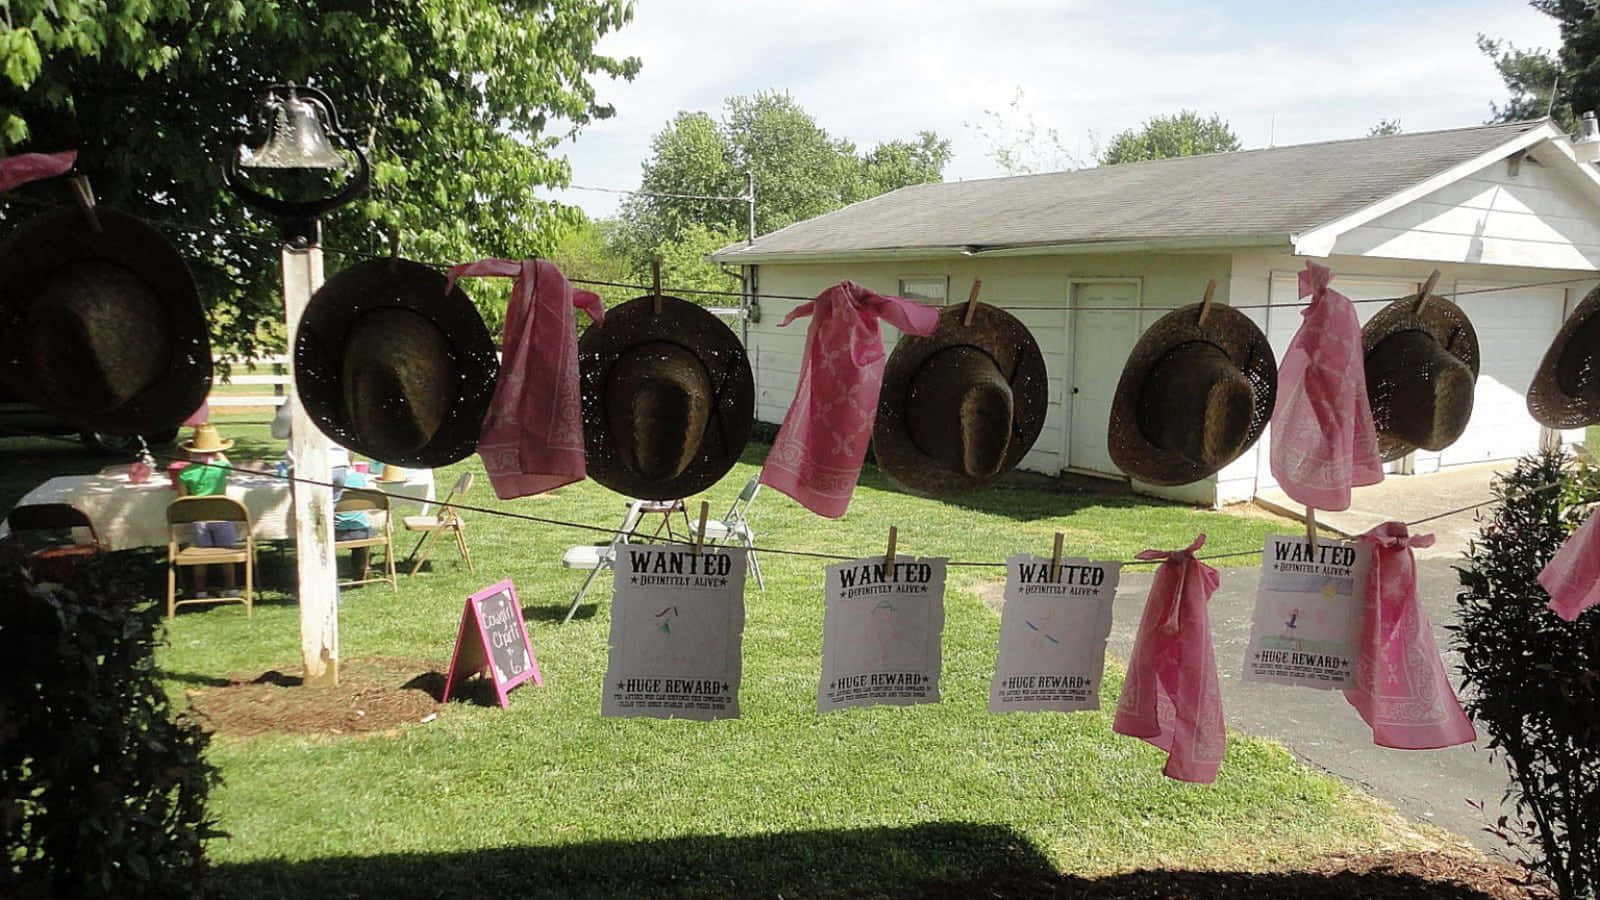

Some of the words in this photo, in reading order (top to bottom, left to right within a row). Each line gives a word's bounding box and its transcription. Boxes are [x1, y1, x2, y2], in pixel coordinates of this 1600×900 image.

[1275, 541, 1356, 567] WANTED
[630, 550, 731, 576] WANTED
[1280, 563, 1319, 574] DEFINITELY
[1322, 566, 1345, 576] ALIVE
[640, 575, 690, 587] DEFINITELY
[694, 577, 720, 588] ALIVE
[840, 563, 931, 588] WANTED
[848, 585, 891, 599] DEFINITELY
[896, 585, 920, 594] ALIVE
[1025, 585, 1066, 595] DEFINITELY
[1070, 586, 1092, 596] ALIVE
[1261, 650, 1288, 663] HUGE
[1292, 652, 1340, 668] REWARD
[626, 679, 661, 692] HUGE
[665, 680, 720, 694] REWARD
[838, 675, 867, 689] HUGE
[871, 673, 920, 685] REWARD
[1008, 676, 1035, 689] HUGE
[1038, 676, 1083, 689] REWARD
